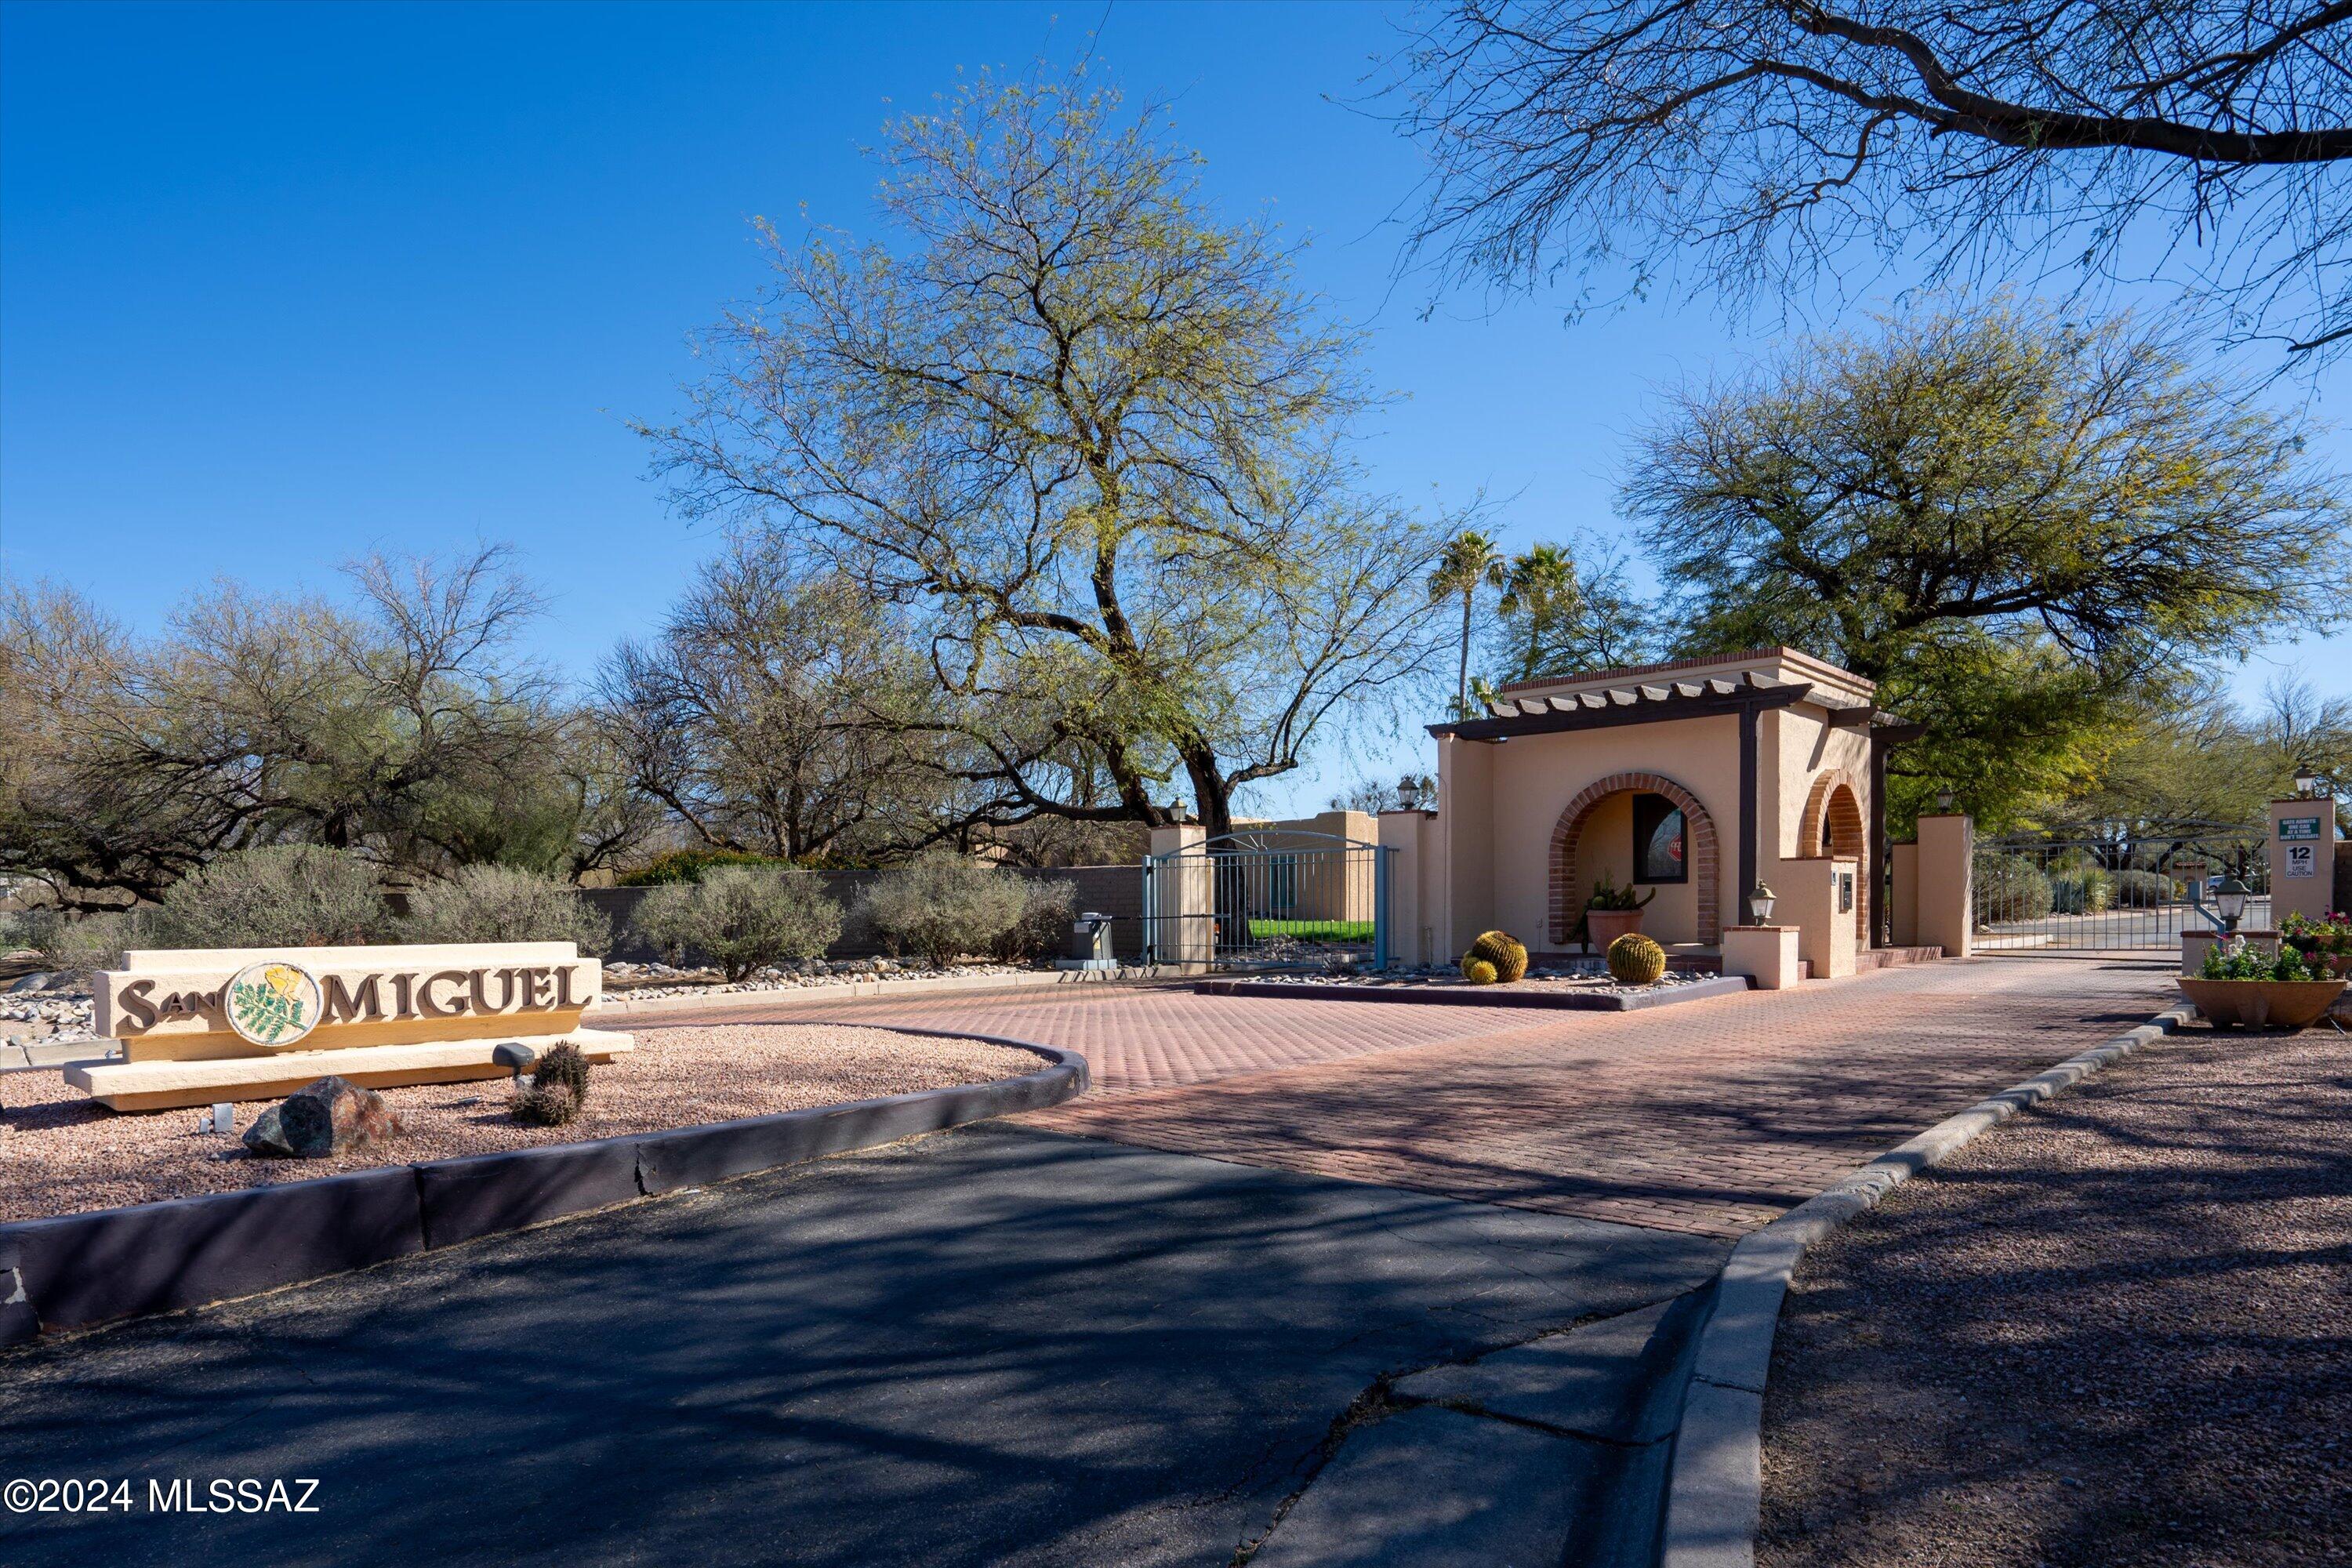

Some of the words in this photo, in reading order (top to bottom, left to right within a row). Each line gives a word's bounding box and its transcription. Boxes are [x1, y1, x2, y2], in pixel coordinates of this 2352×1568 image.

[2289, 847, 2310, 859] 12
[122, 978, 220, 1029] SAN
[319, 965, 593, 1022] MIGUEL
